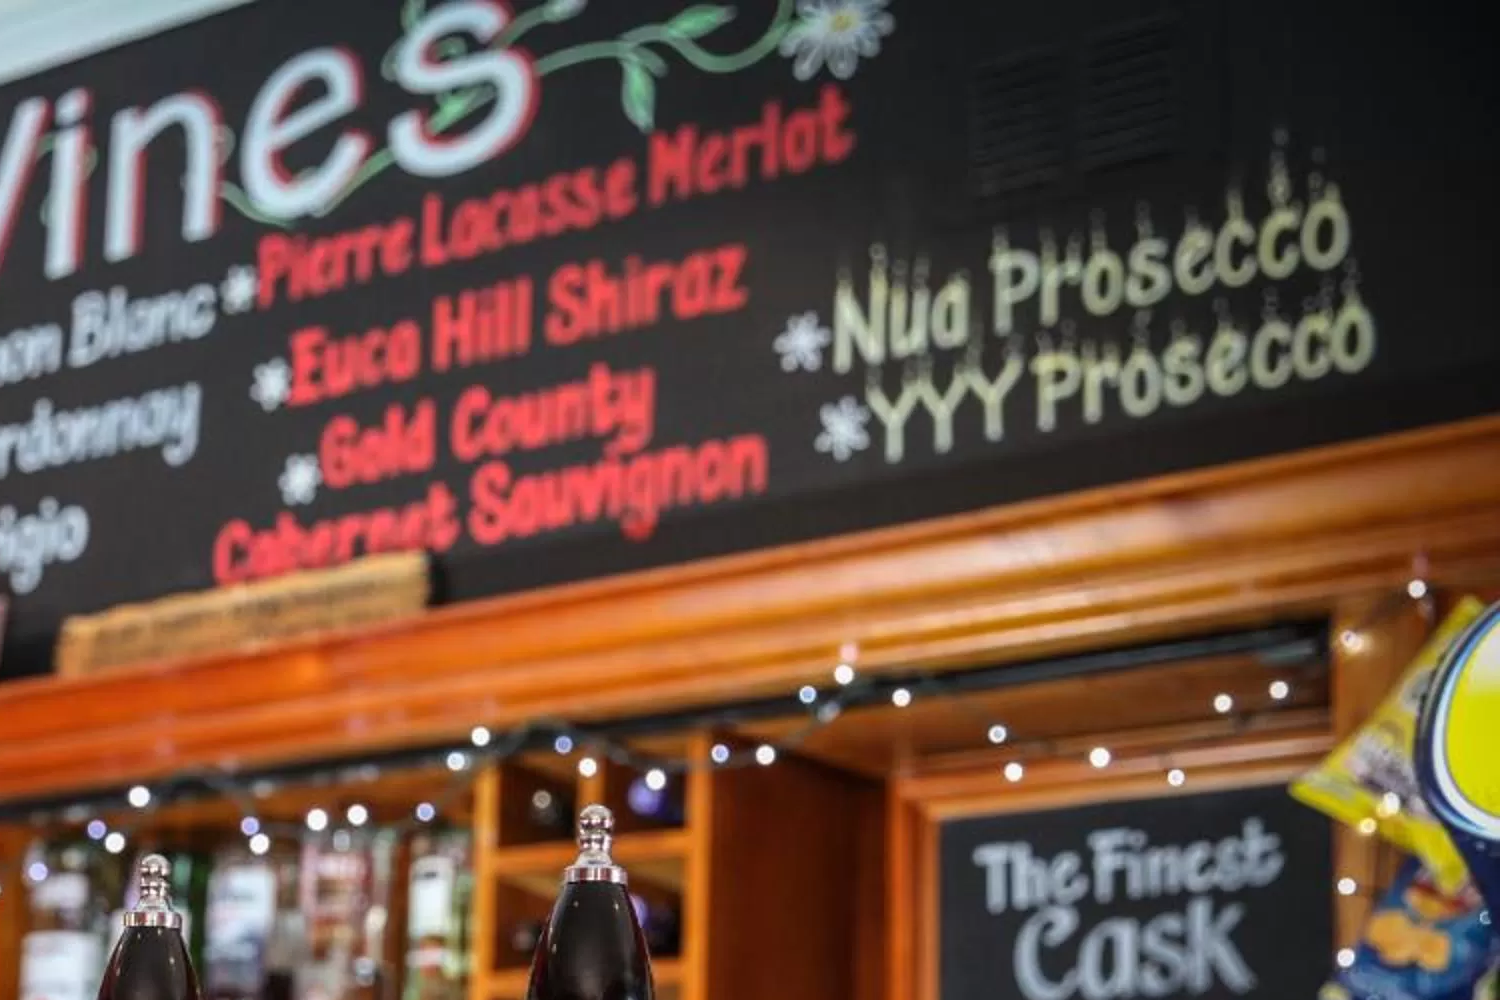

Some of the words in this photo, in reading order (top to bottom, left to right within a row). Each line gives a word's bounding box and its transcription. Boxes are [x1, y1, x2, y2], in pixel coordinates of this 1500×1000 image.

[257, 216, 414, 311] Pierre
[647, 82, 857, 207] Merlot
[67, 283, 217, 368] Blanc
[432, 275, 534, 372] Hill
[544, 242, 749, 346] Shiraz
[991, 196, 1350, 336] Prosecco
[319, 397, 435, 489] Gold
[451, 362, 657, 461] County
[1035, 300, 1375, 431] Prosecco
[469, 433, 769, 544] Sauvignon
[973, 842, 1089, 912] The
[1087, 817, 1285, 902] Finest
